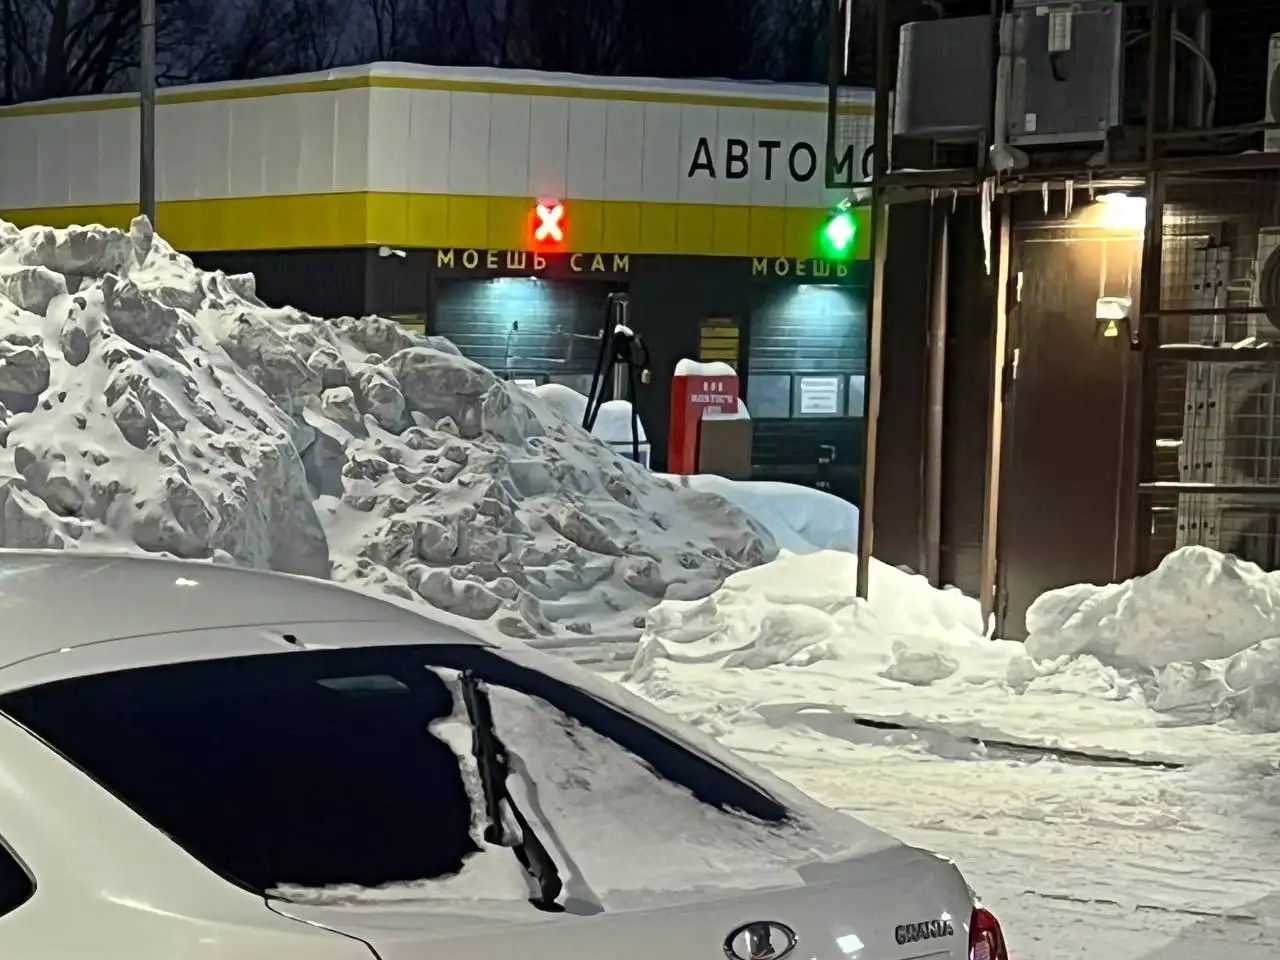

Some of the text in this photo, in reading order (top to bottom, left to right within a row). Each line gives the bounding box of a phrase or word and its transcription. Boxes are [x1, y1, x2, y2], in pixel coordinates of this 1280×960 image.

[437, 249, 630, 273] МОЕШЬ САМ
[752, 257, 848, 277] МОЕШЬ
